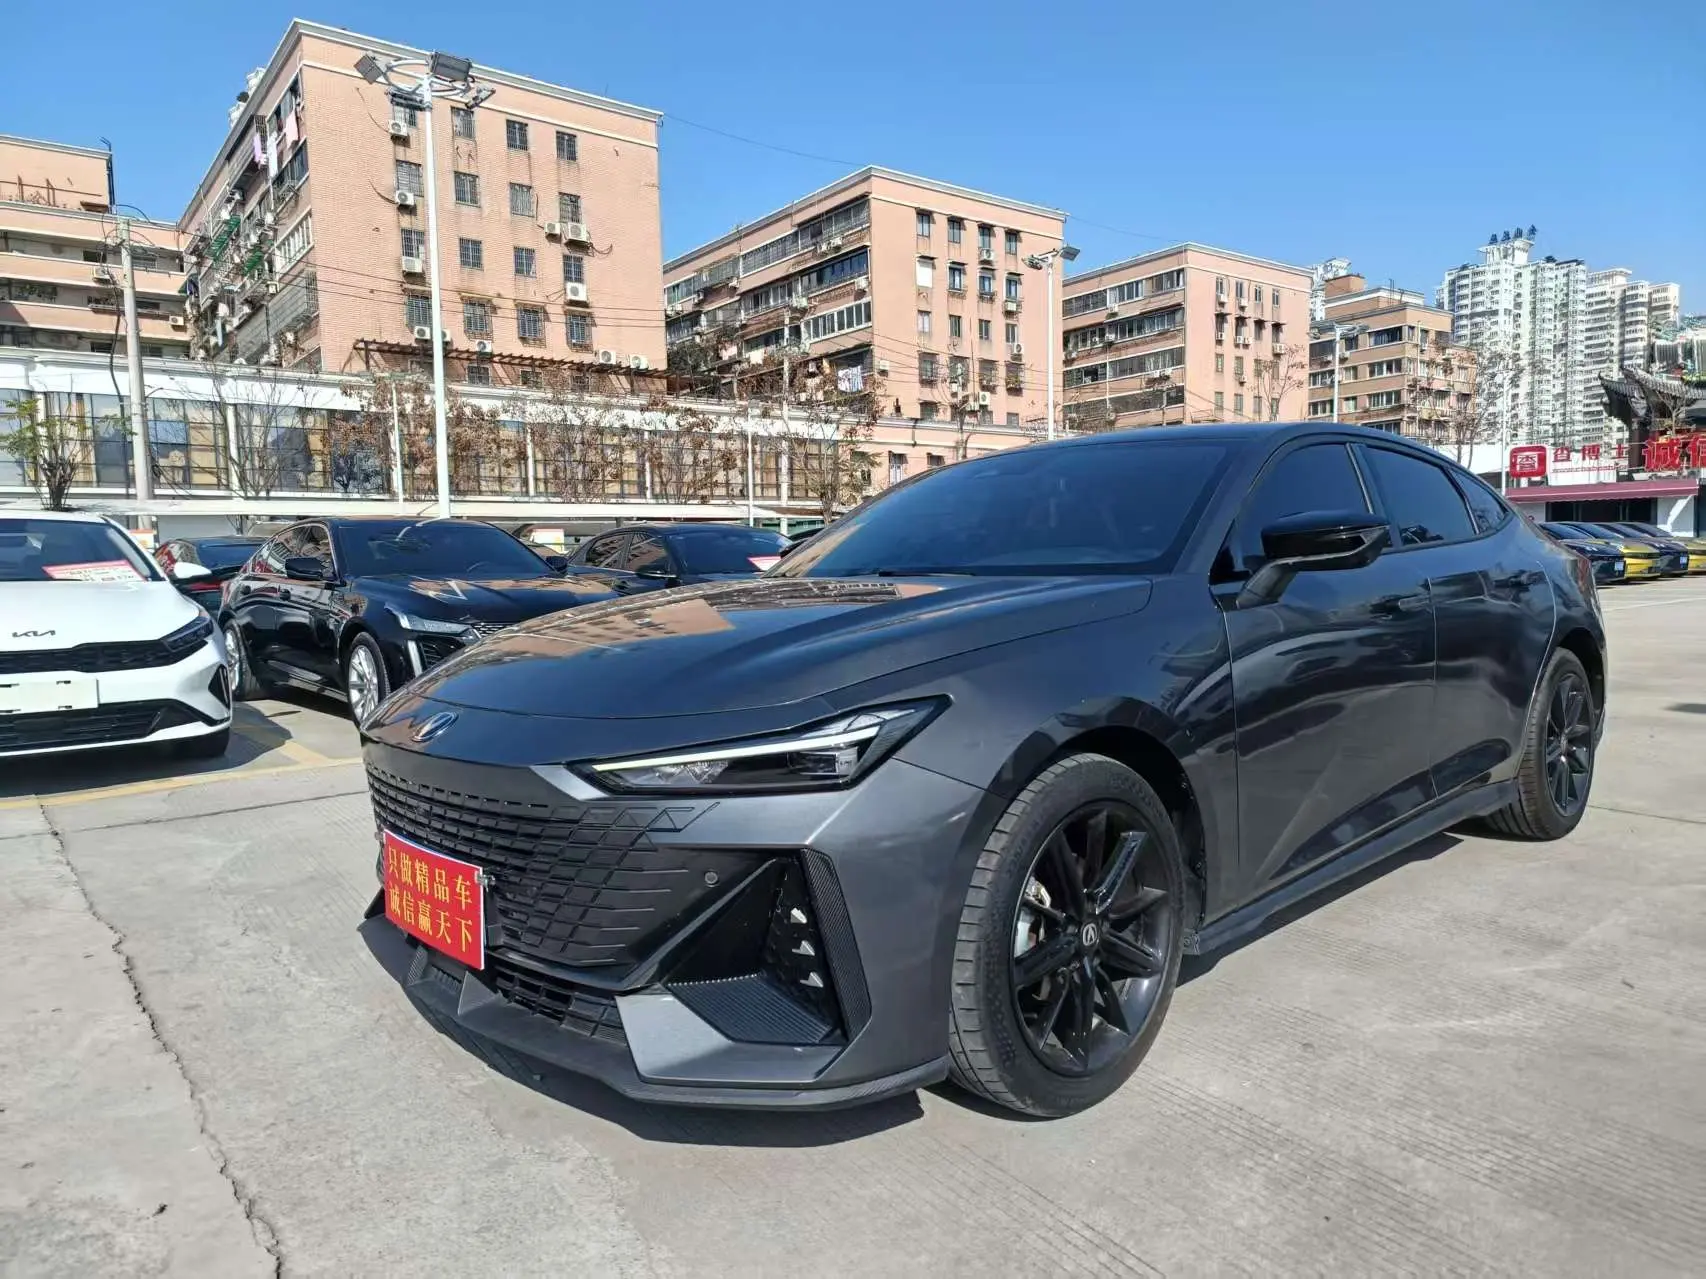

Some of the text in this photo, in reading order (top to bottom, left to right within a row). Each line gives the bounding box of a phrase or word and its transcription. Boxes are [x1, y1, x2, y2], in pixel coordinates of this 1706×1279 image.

[388, 846, 472, 910] 只做精品车
[390, 883, 472, 953] 诚信赢天下
